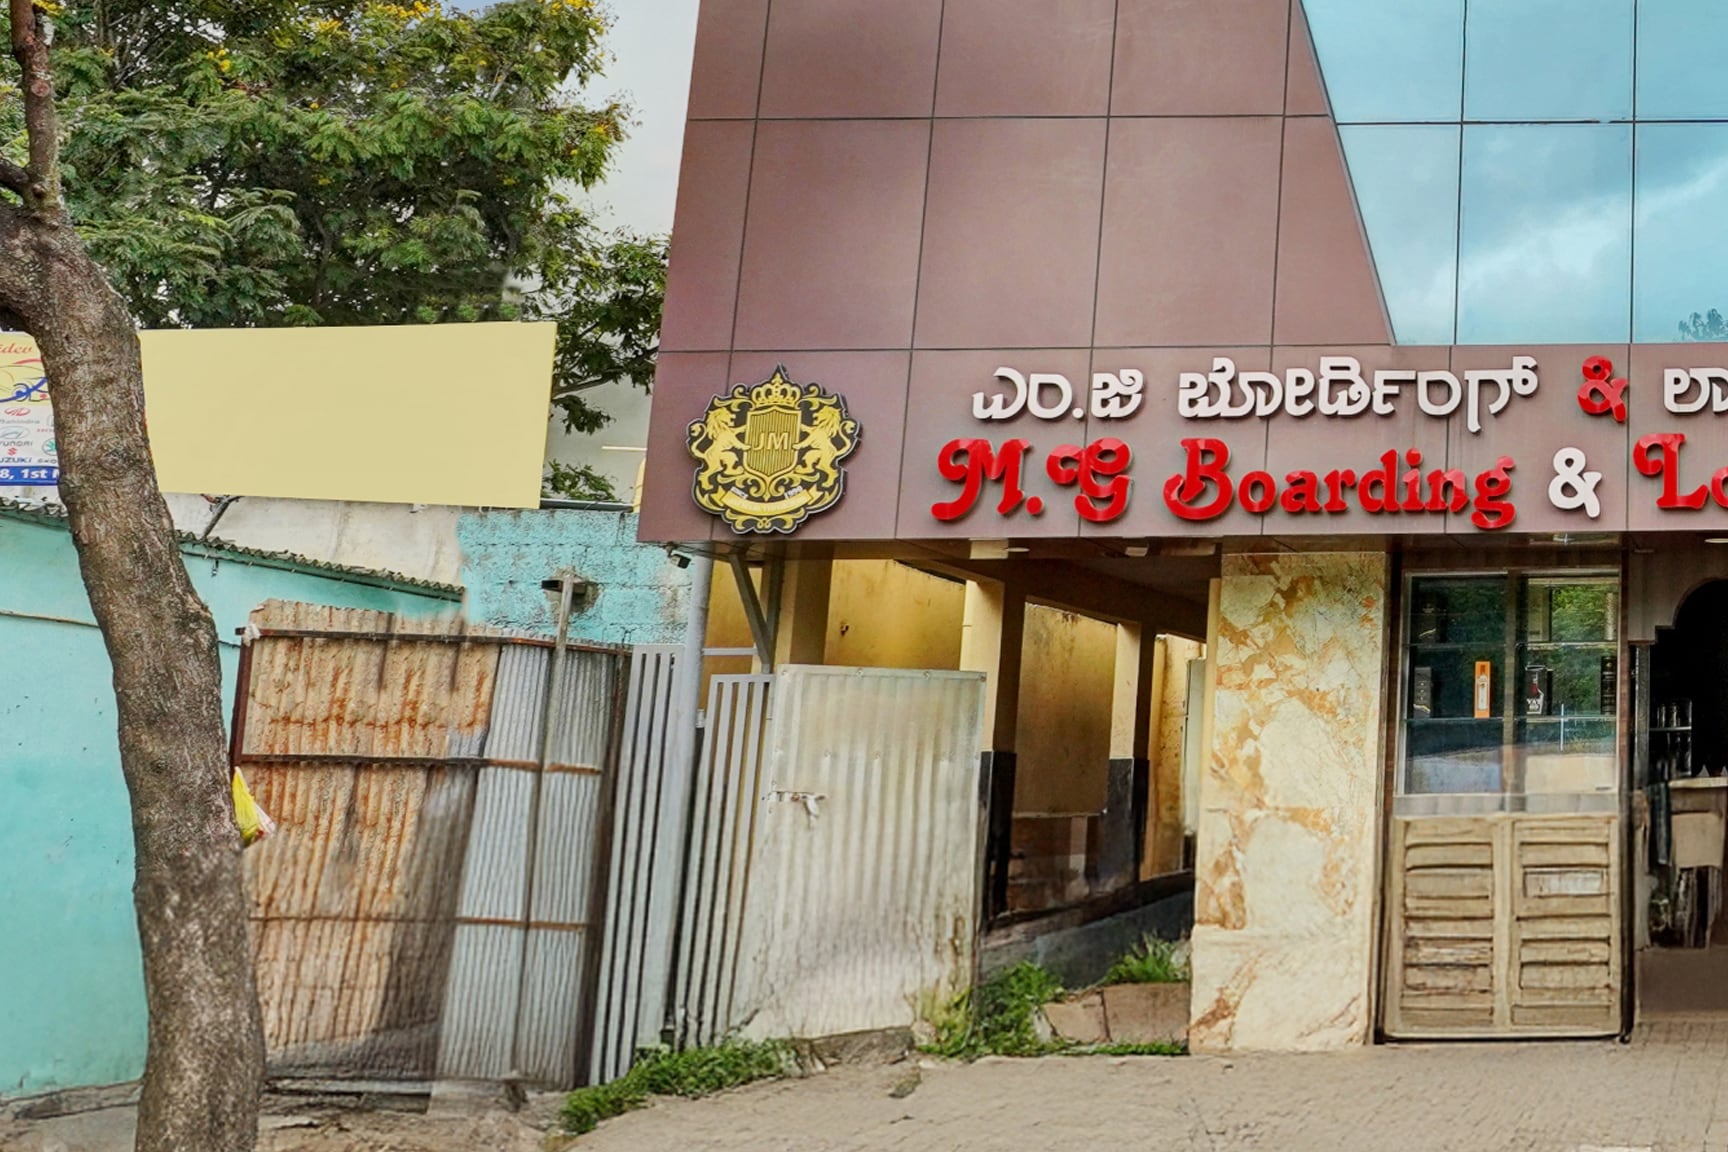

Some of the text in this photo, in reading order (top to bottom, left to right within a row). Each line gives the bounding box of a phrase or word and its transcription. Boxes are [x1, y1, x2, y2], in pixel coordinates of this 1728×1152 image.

[1577, 355, 1628, 422] &
[753, 432, 789, 450] JM
[21, 468, 48, 479] 1st
[1163, 437, 1517, 530] Boarding
[1548, 447, 1602, 518] &
